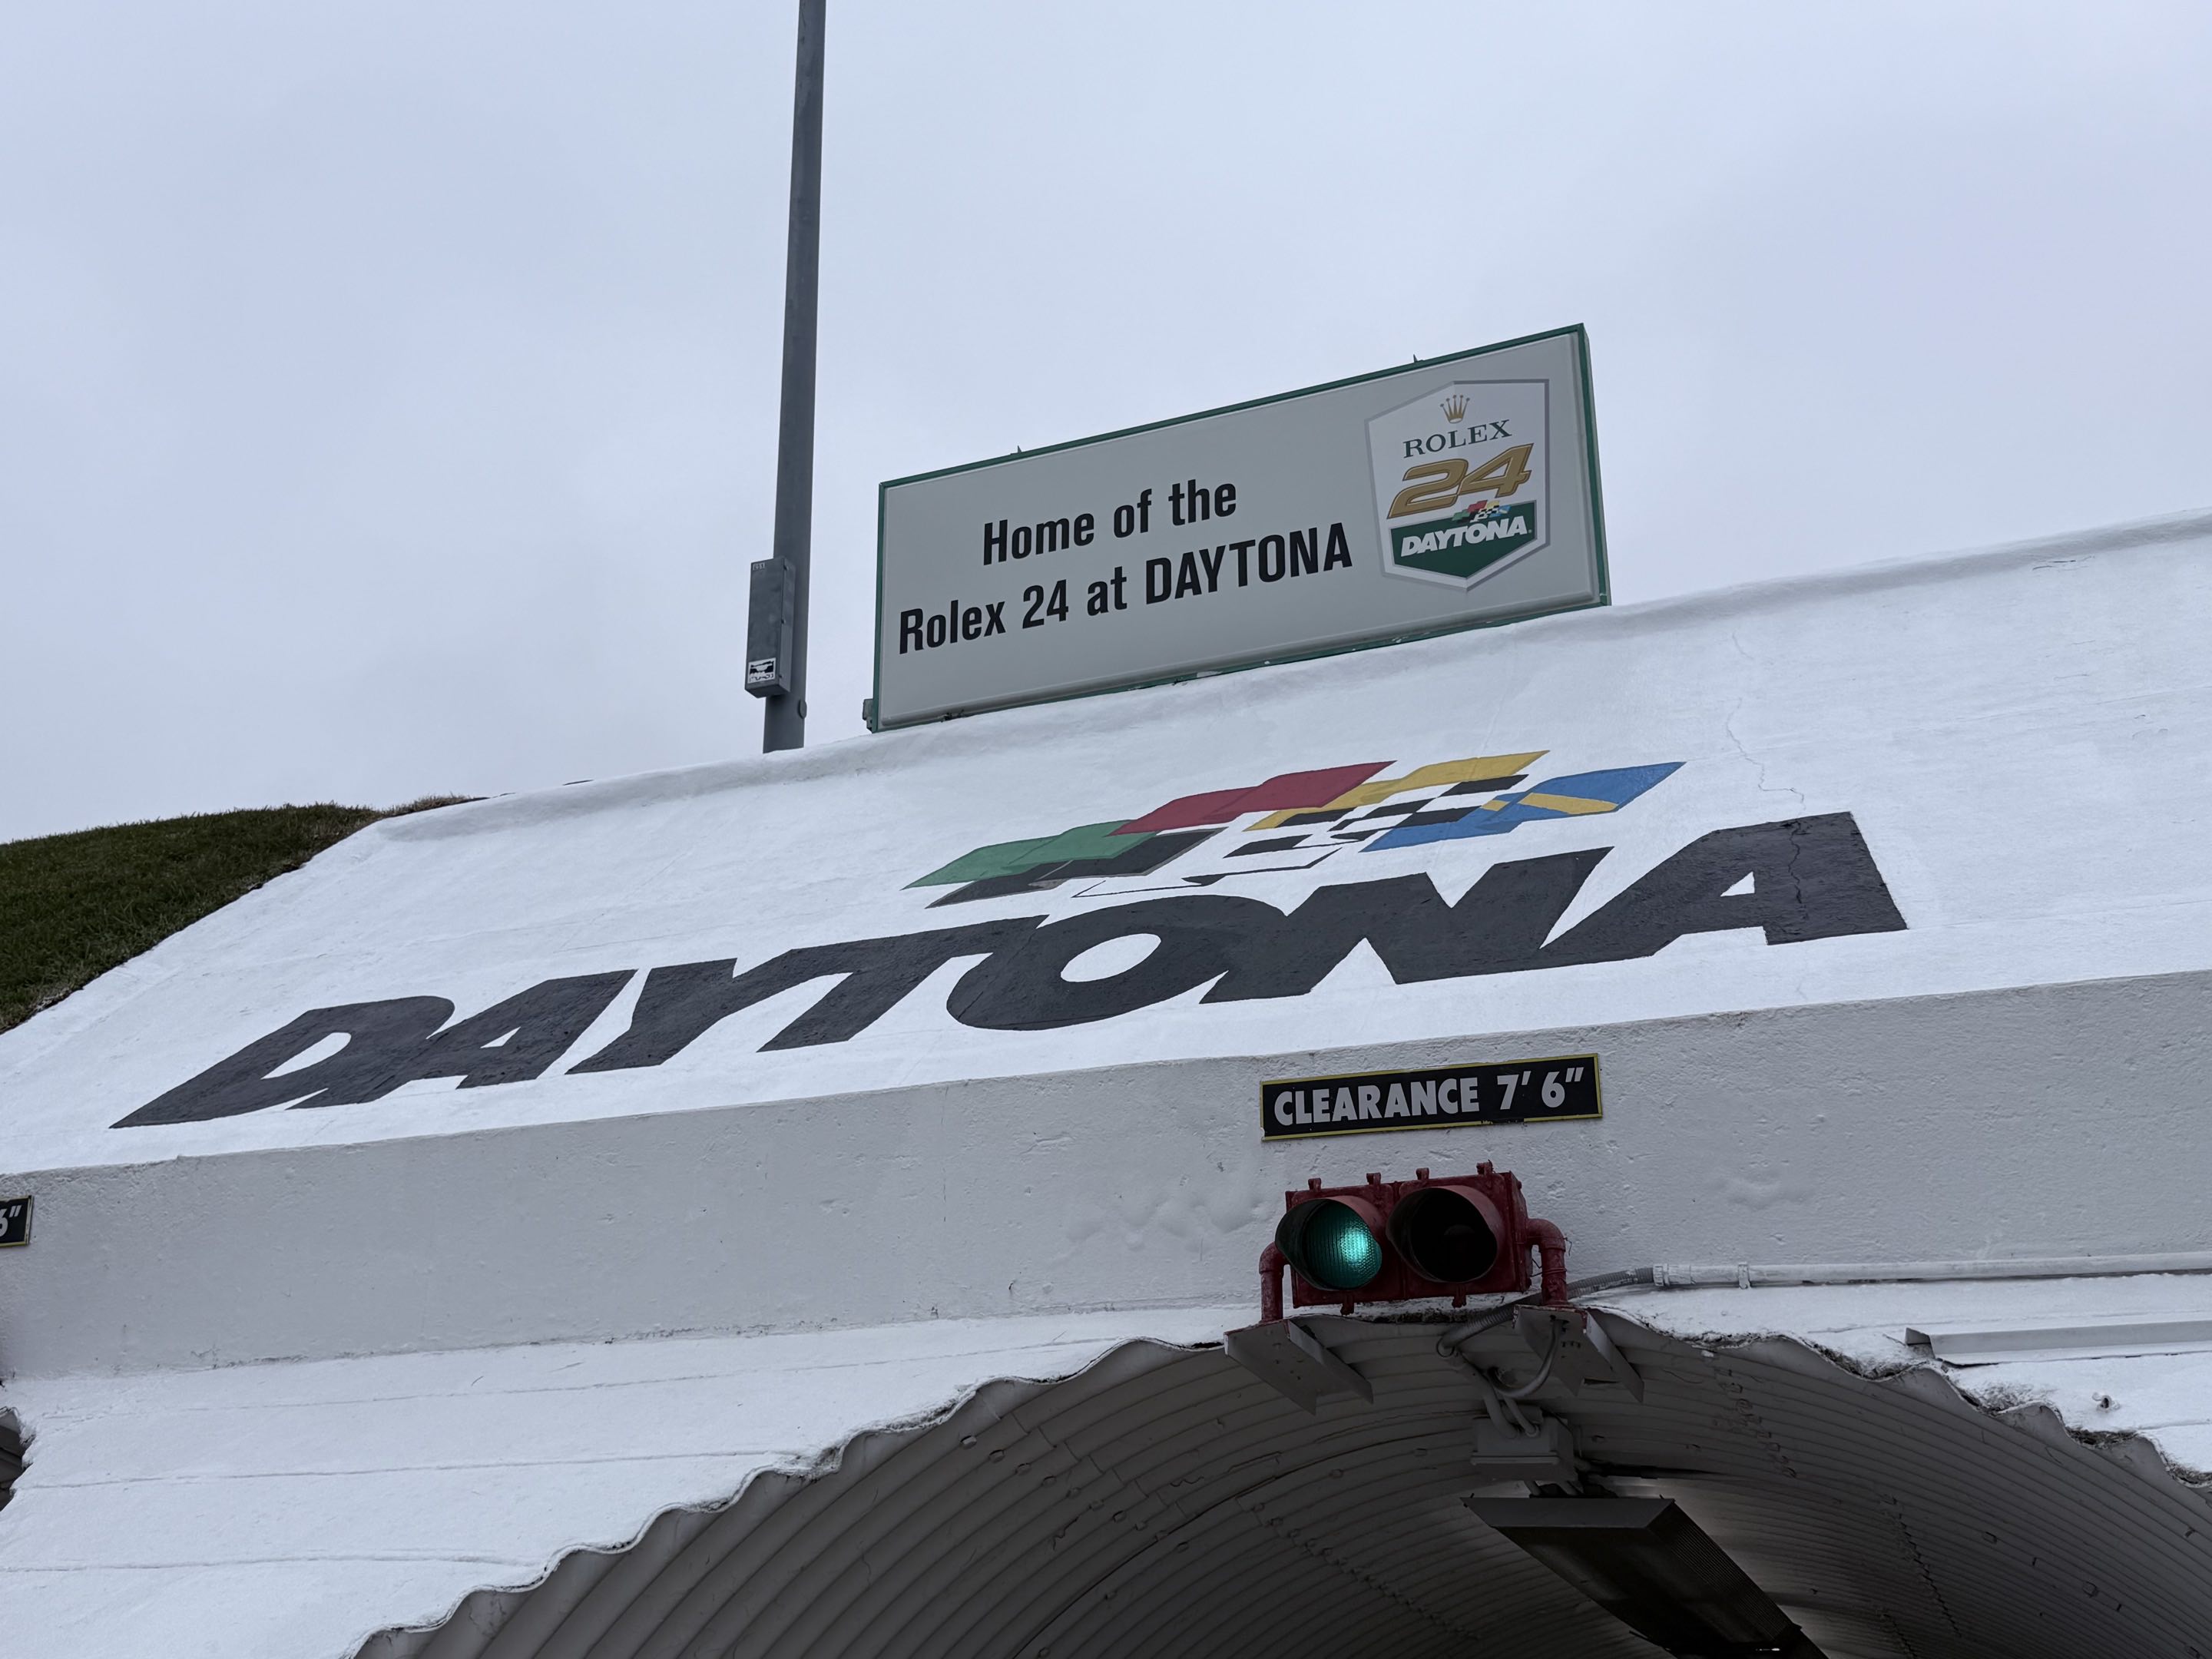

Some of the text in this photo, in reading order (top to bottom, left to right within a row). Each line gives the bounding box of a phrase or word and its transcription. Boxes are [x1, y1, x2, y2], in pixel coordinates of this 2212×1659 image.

[1402, 419, 1512, 459] ROLEX
[1386, 442, 1535, 520] 24
[983, 478, 1237, 565] Home of the
[1400, 515, 1528, 558] DAYTONA
[899, 522, 1353, 654] Rolex 24 at DAYTONA
[108, 811, 1909, 1129] DAYTONA
[1273, 1077, 1480, 1127] CLEARANCE
[1496, 1070, 1531, 1111] 7'
